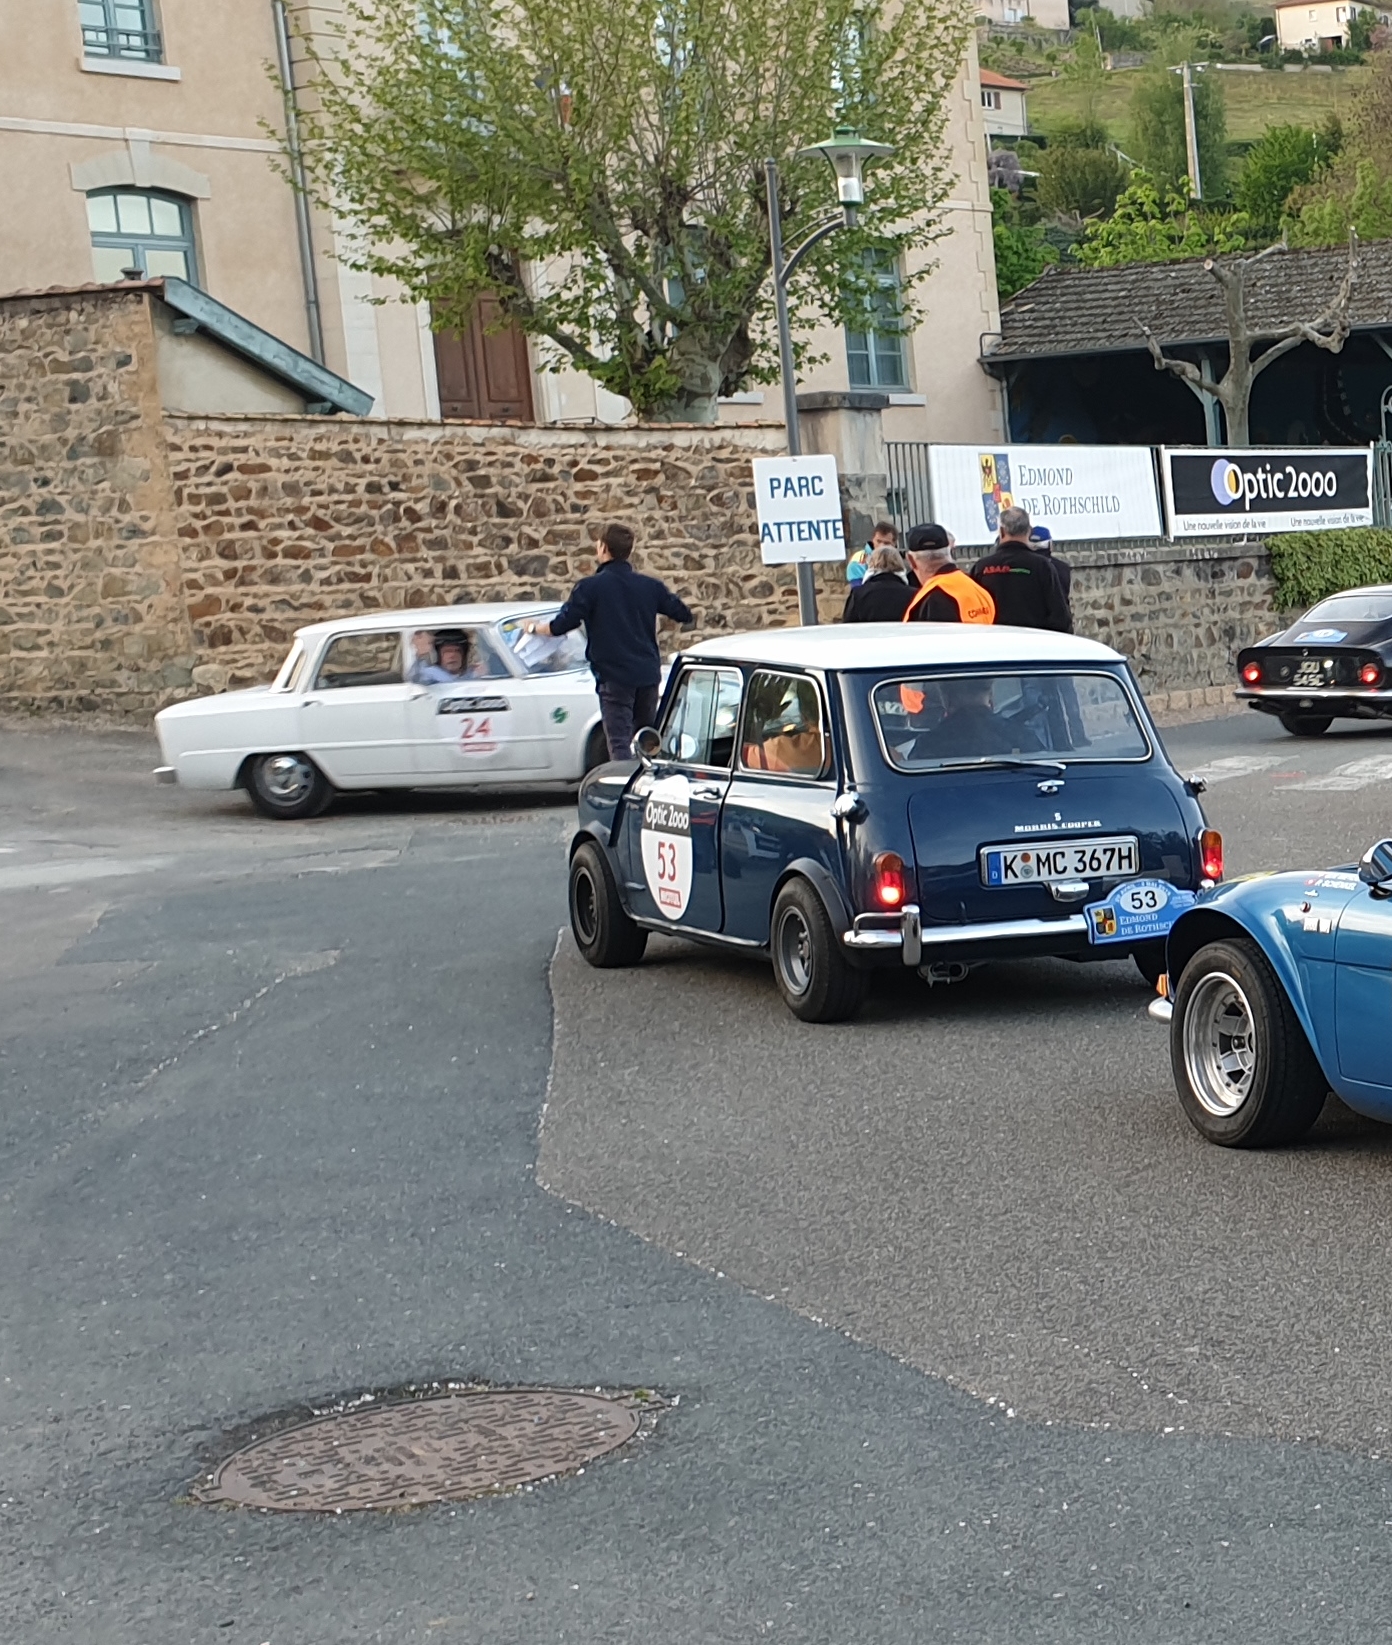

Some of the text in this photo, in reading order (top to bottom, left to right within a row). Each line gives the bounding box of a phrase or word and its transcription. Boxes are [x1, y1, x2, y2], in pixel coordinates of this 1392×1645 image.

[769, 475, 824, 499] PARC
[1018, 464, 1073, 487] EDMOND
[1224, 462, 1284, 511] Optic
[1022, 494, 1121, 517] DE ROTHSCHILD
[760, 518, 844, 543] ATTENTE
[1183, 518, 1266, 531] Une nouvelle vision de la vie
[1291, 517, 1301, 527] Une
[1302, 516, 1326, 526] nouvelle
[1327, 515, 1342, 525] vision
[460, 717, 492, 739] 24
[646, 801, 667, 829] Optic
[657, 841, 677, 882] 53
[1003, 846, 1133, 879] K MC 367H
[1131, 890, 1157, 910] 53
[1119, 913, 1158, 925] EDMOND
[1121, 926, 1133, 935] DE
